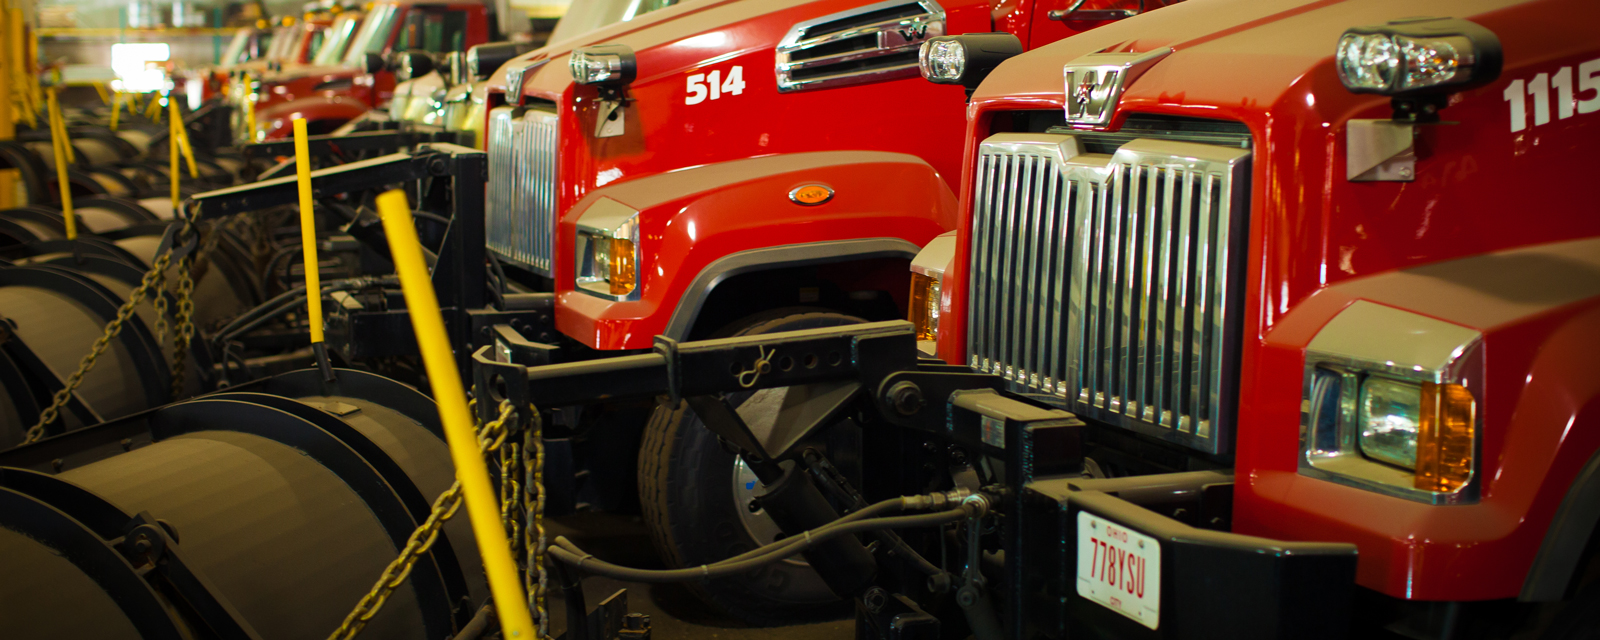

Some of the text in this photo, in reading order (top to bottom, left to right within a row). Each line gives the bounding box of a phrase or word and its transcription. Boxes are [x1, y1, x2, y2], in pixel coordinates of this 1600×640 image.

[685, 65, 746, 106] 514
[1503, 57, 1600, 133] 1115
[1106, 525, 1128, 543] OHIO
[1090, 537, 1146, 599] 778YSU
